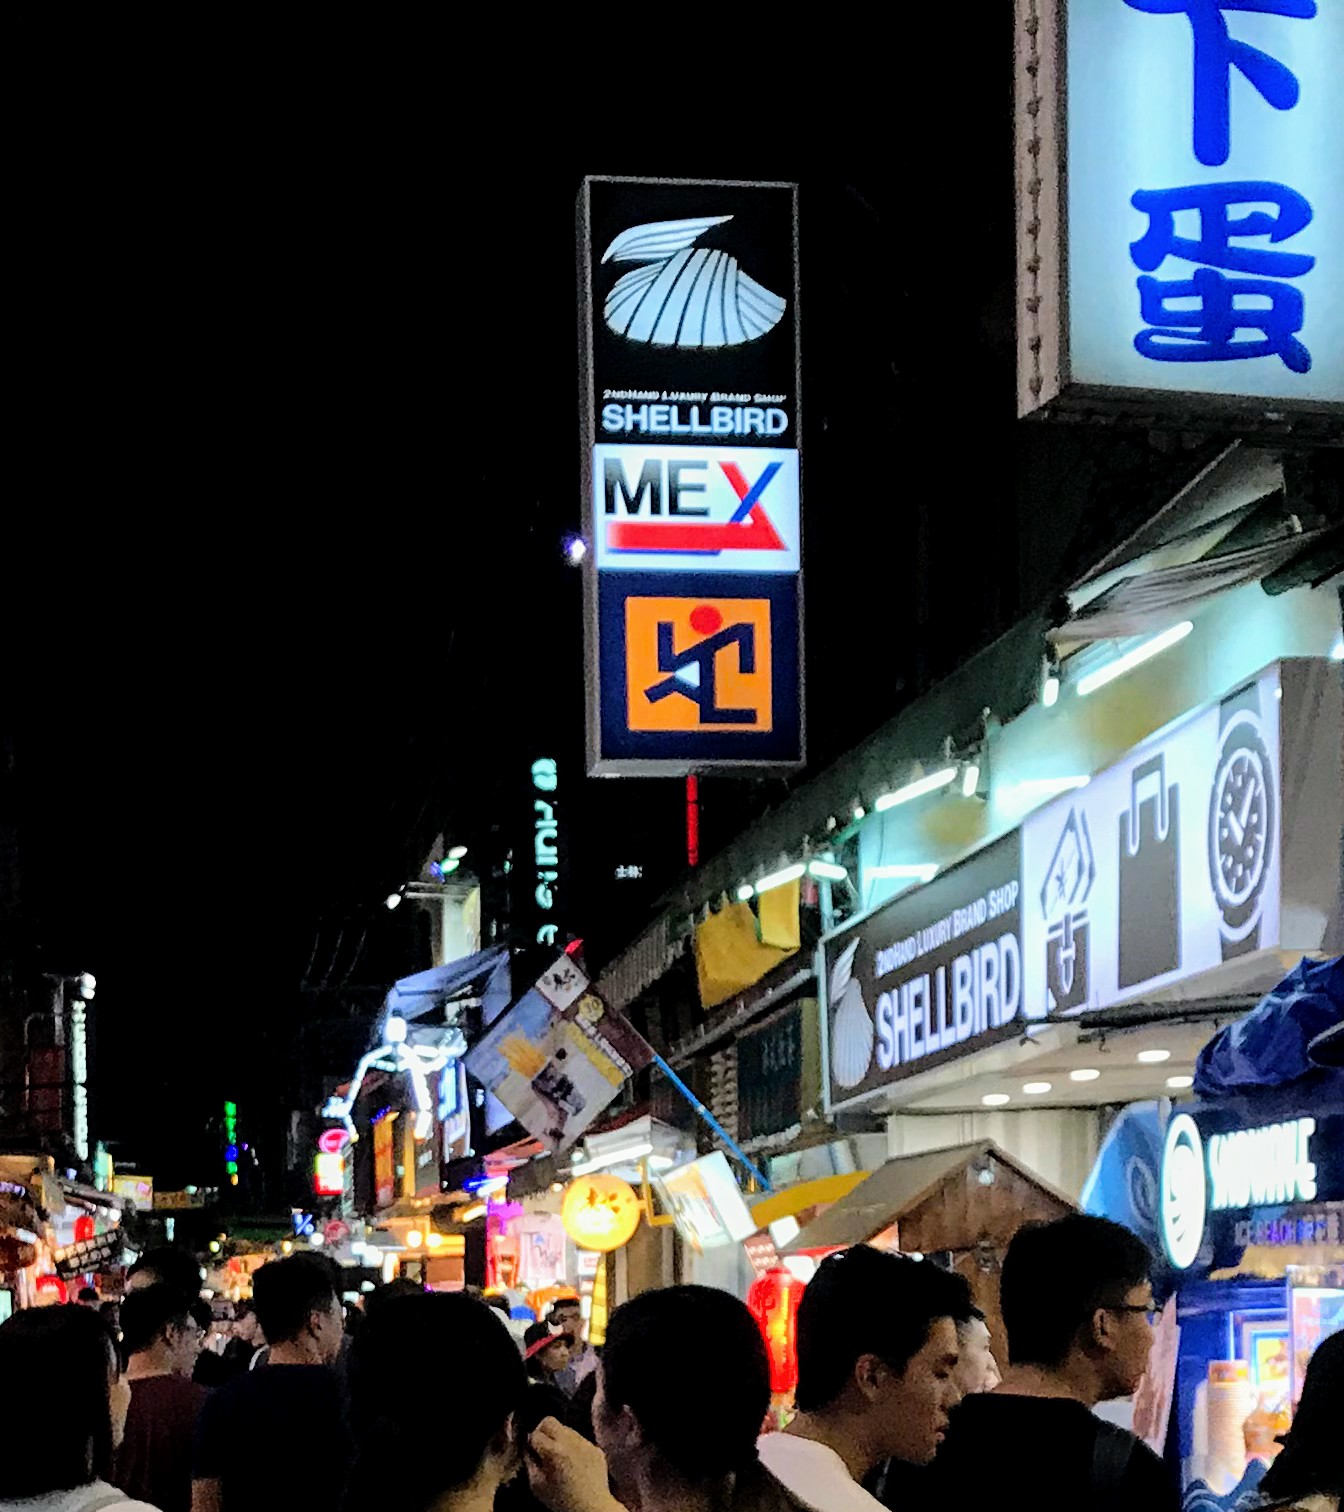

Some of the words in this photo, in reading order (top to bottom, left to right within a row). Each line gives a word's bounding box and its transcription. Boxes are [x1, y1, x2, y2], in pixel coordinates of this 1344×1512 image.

[602, 403, 789, 435] SHELLBIRD
[603, 457, 786, 522] MEX
[987, 879, 1019, 919] SHOP
[875, 932, 1020, 1072] SHELLBIRD
